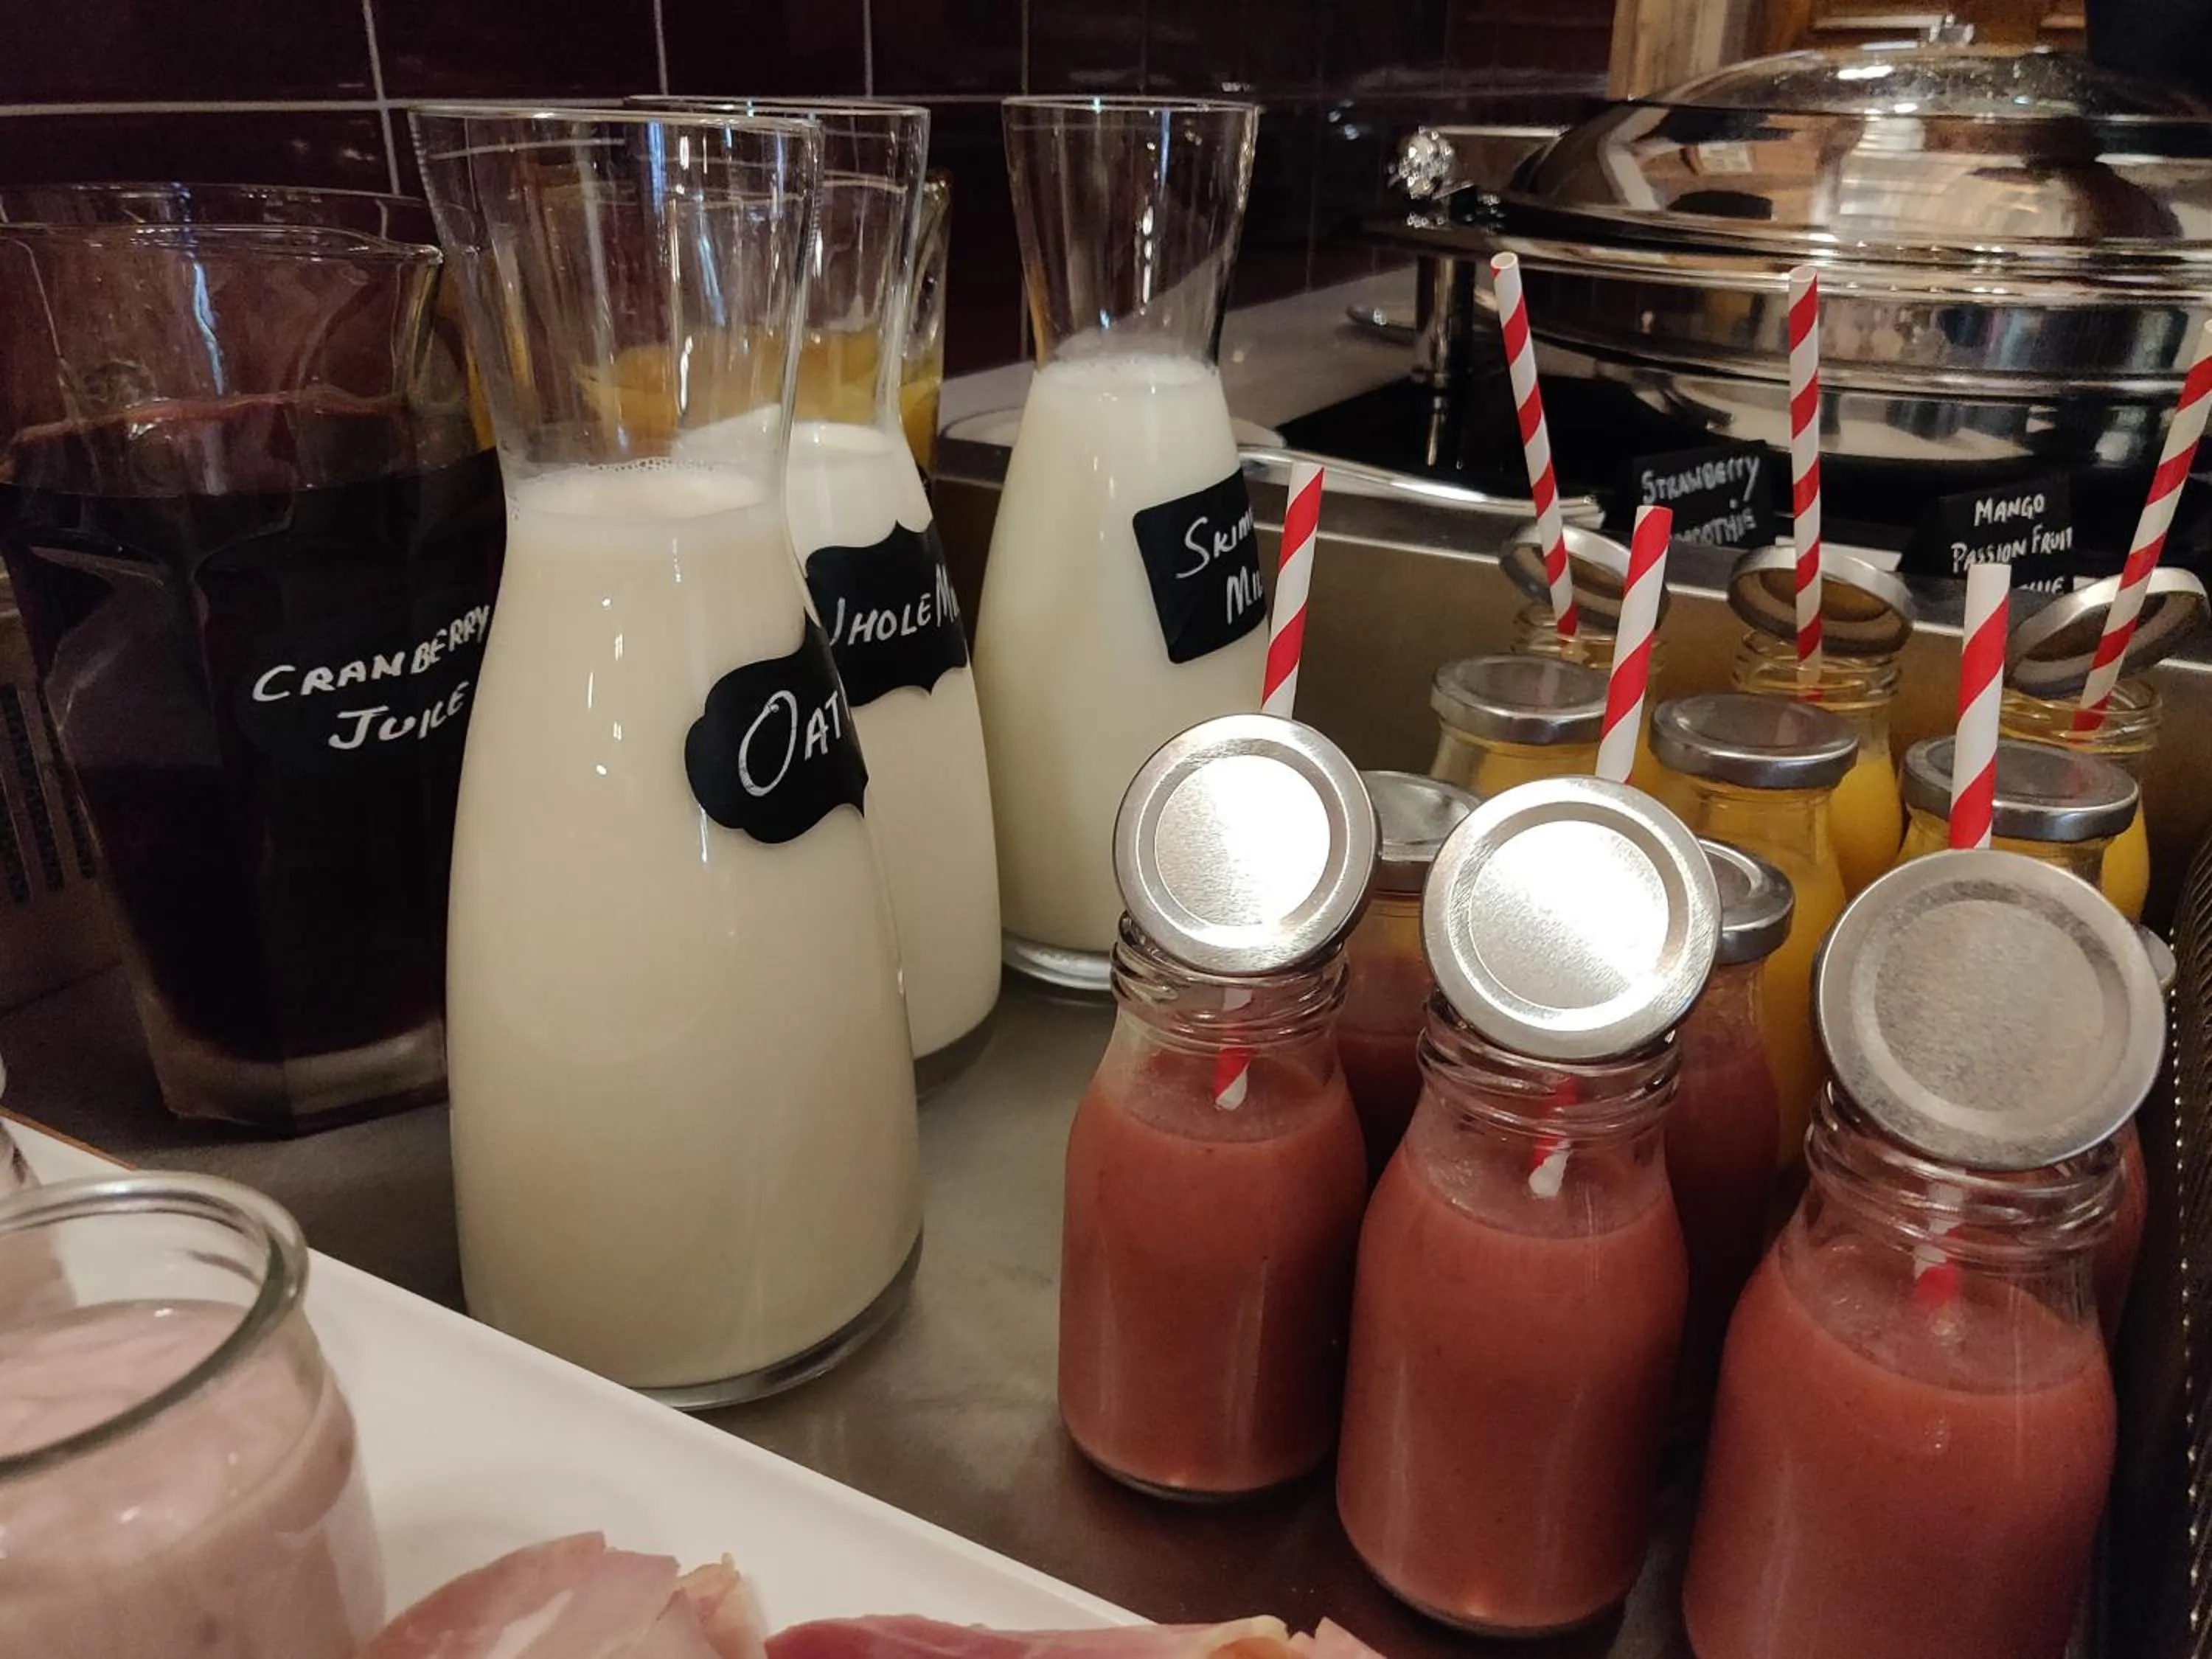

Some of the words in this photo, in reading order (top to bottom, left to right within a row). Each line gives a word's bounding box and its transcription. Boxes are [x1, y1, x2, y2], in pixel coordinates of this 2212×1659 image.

[1973, 493, 2045, 526] MANGO
[1951, 541, 2027, 574] PASSION
[252, 605, 490, 701] CRANBERRY
[328, 681, 470, 749] JUICE
[738, 689, 842, 797] OAT
